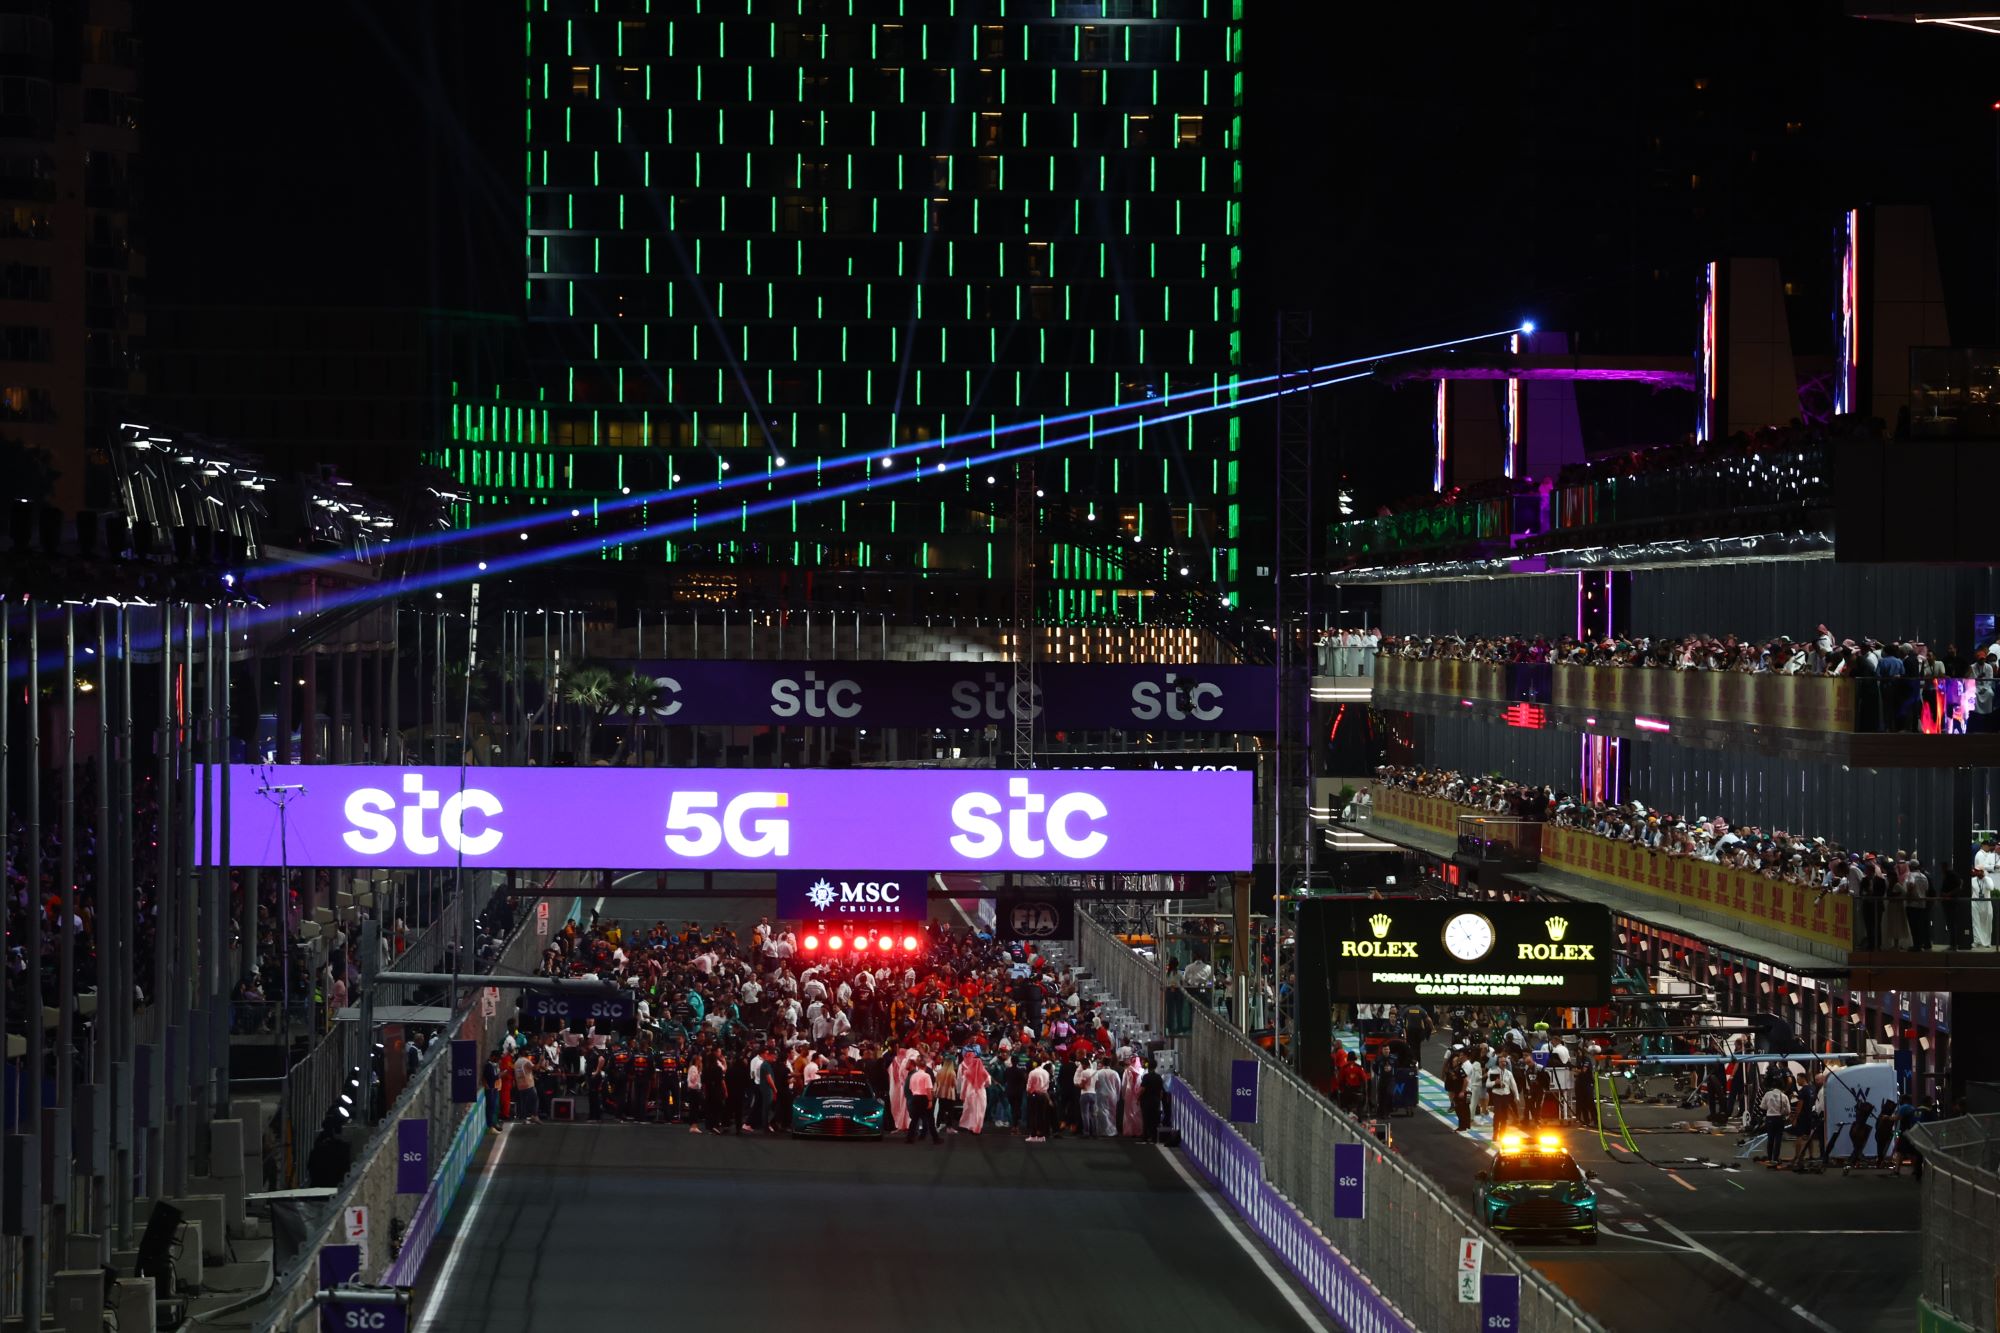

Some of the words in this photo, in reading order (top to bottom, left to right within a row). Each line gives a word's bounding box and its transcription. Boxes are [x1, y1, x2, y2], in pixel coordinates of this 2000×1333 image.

[770, 671, 862, 718] stc
[950, 672, 1042, 720] stc
[1131, 672, 1224, 721] stc
[343, 773, 503, 855] stc
[950, 777, 1108, 859] stc
[665, 791, 791, 858] 5G
[839, 882, 900, 902] MSC
[839, 905, 900, 913] CRUISES
[1341, 940, 1419, 958] ROLEX
[1517, 943, 1595, 961] ROLEX
[1372, 972, 1433, 984] FORMULA
[1434, 973, 1442, 984] 1
[1443, 973, 1467, 985] STC
[1467, 974, 1506, 985] SAUDI
[1507, 974, 1564, 986] ARABIAN
[1415, 984, 1460, 995] GRAND
[1460, 985, 1489, 996] PRIX
[537, 999, 569, 1015] stc
[591, 1002, 623, 1018] stc
[1236, 1087, 1252, 1097] stc
[403, 1151, 422, 1162] stc
[1339, 1176, 1357, 1187] stc
[346, 1307, 385, 1329] stc
[1488, 1315, 1511, 1328] stc
